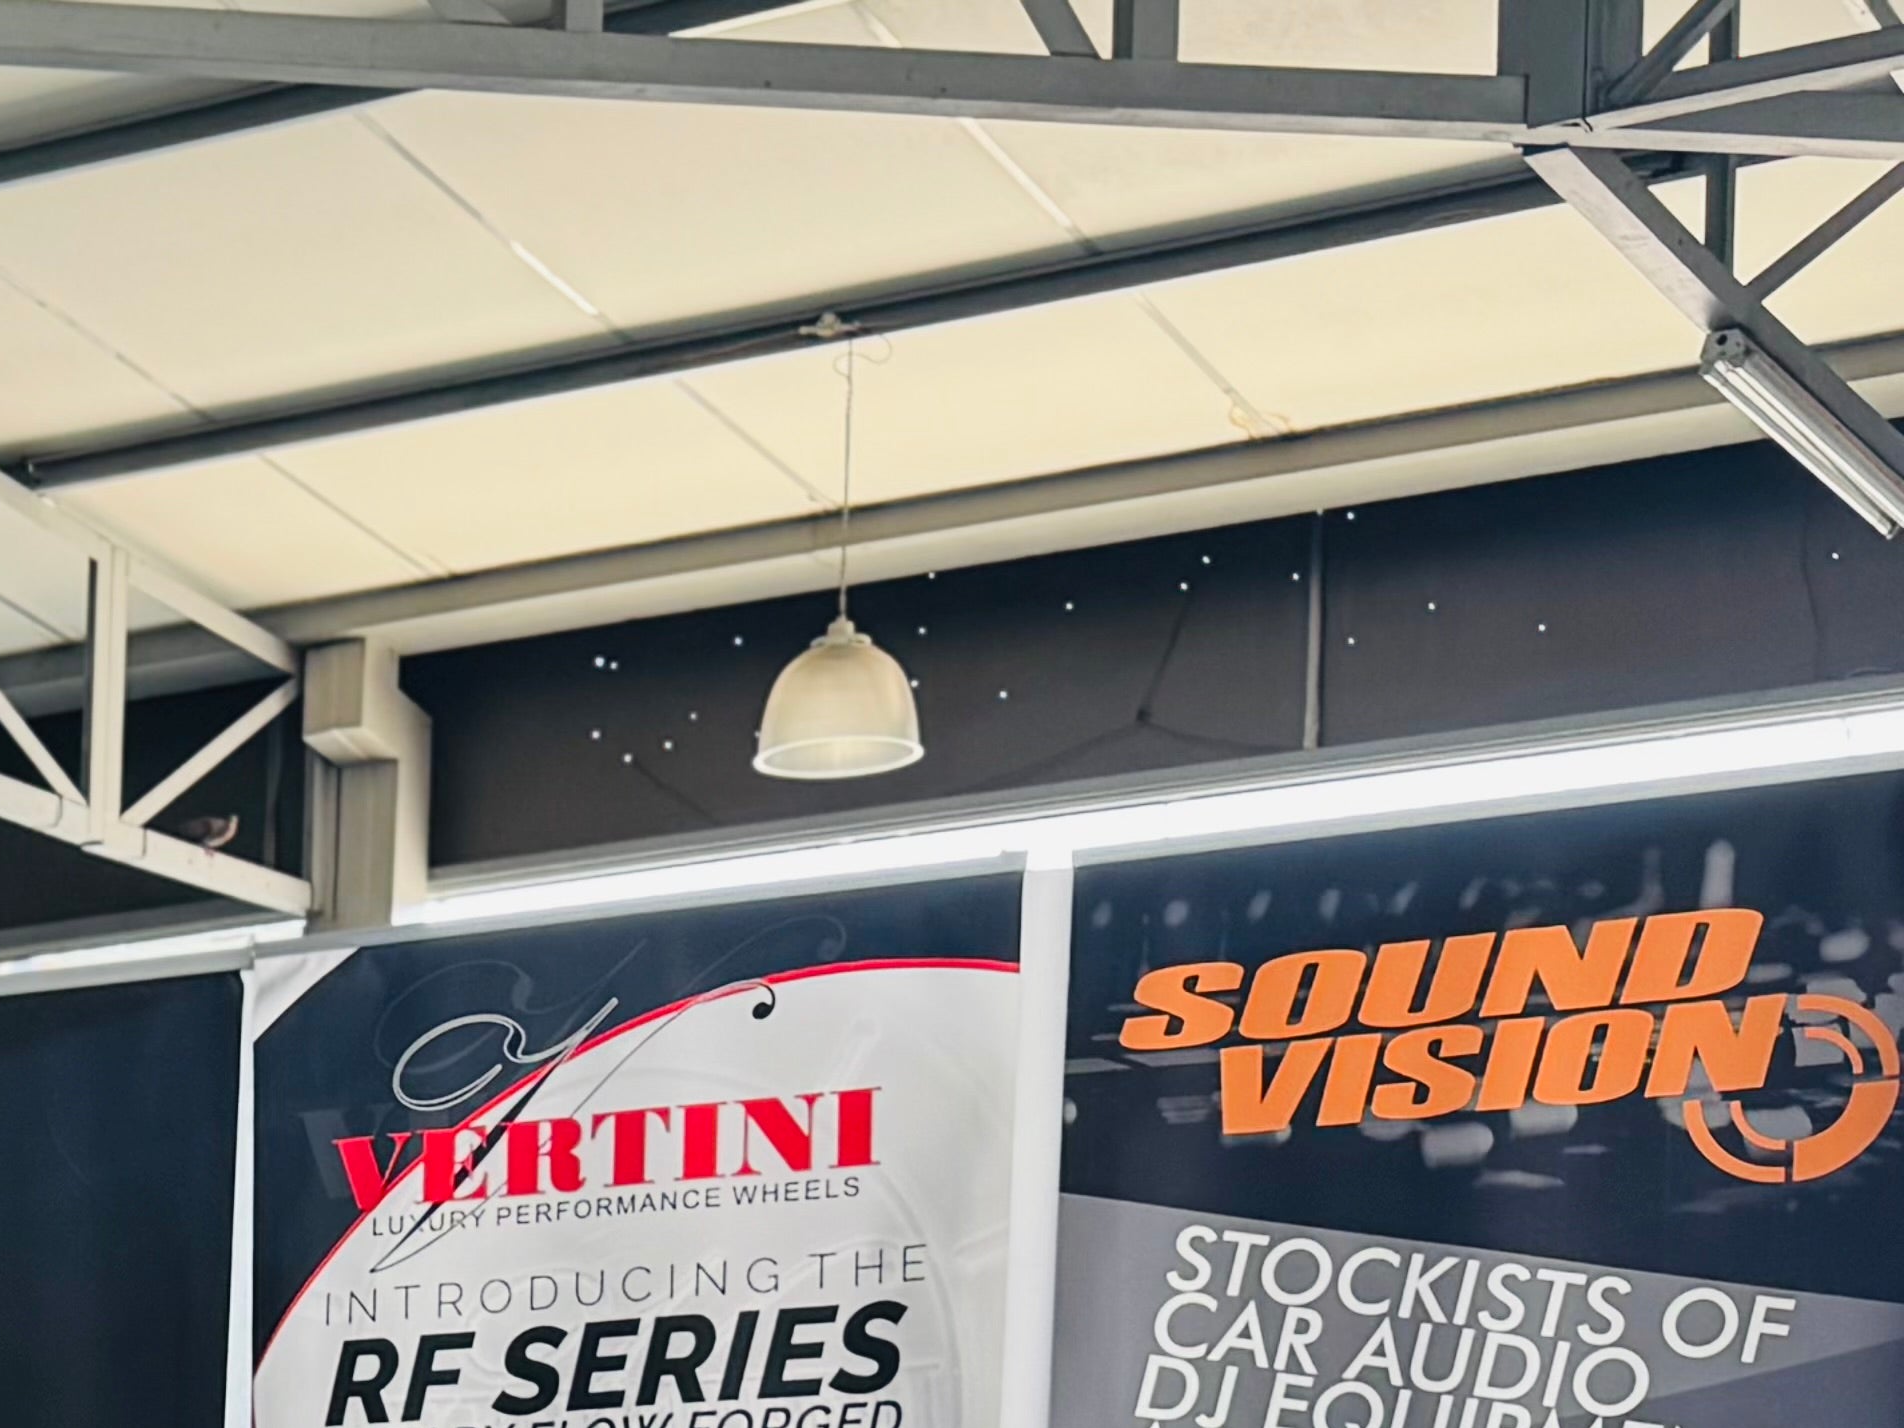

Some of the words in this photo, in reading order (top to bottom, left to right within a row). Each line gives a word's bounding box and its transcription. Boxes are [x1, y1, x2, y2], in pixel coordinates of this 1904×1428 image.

[1119, 908, 1764, 1051] SOUND
[1220, 993, 1787, 1136] VISION
[333, 1086, 883, 1211] VERTINI
[371, 1209, 483, 1238] LUXURY
[494, 1187, 721, 1226] PERFORMANCE
[732, 1176, 860, 1205] WHEELS
[324, 1256, 780, 1328] INTRODUCING
[809, 1243, 928, 1288] THE
[1166, 1224, 1632, 1346] STOCKISTS
[1662, 1288, 1795, 1364] OF
[324, 1330, 475, 1427] RF
[493, 1299, 908, 1416] SERIES
[1134, 1354, 1235, 1428] DJ
[1154, 1292, 1322, 1377] CAR
[1342, 1316, 1649, 1416] AUDIO
